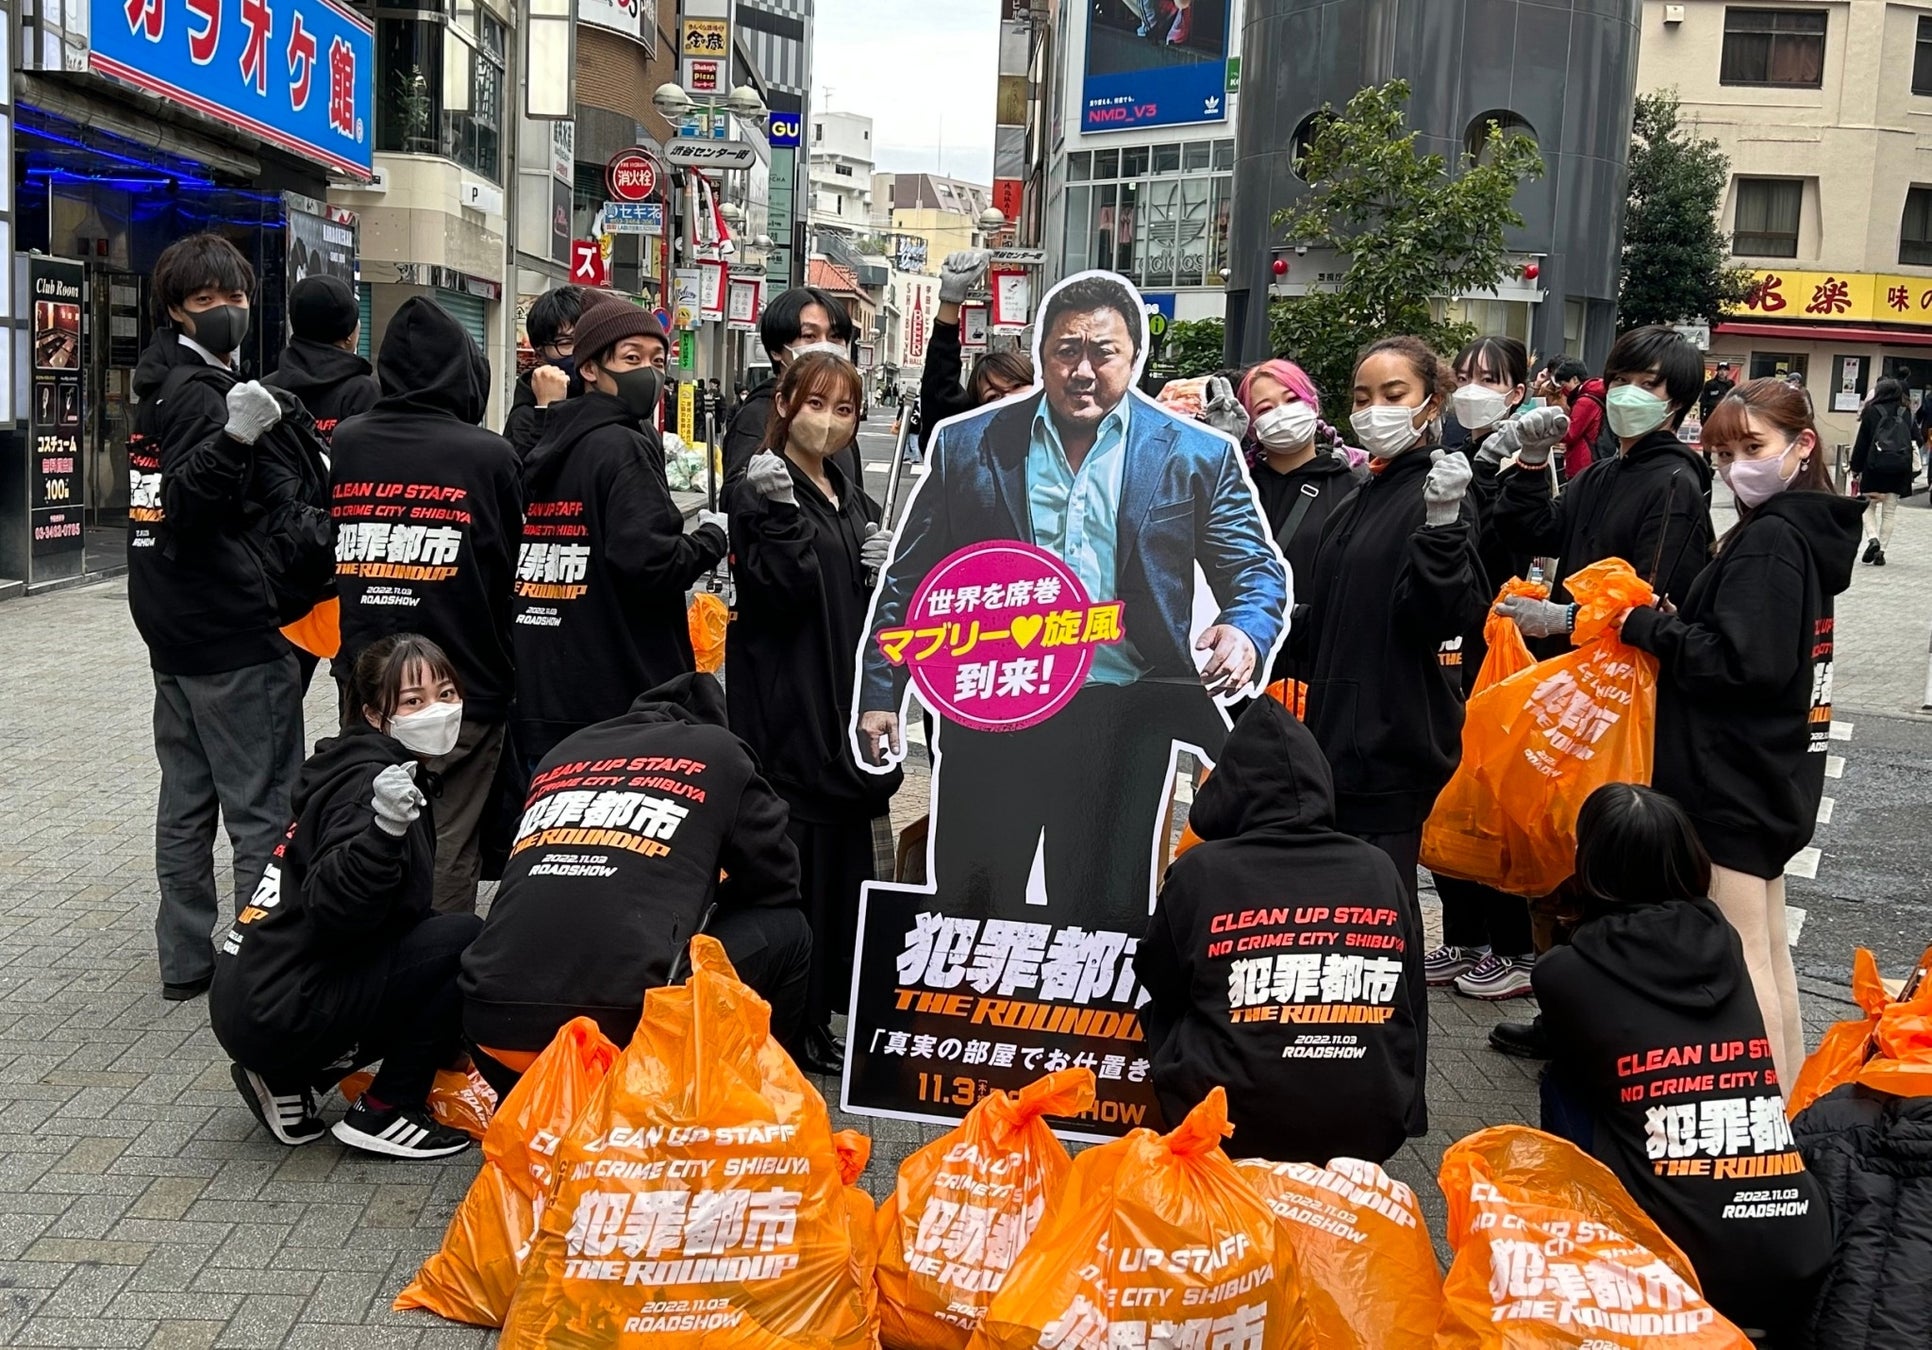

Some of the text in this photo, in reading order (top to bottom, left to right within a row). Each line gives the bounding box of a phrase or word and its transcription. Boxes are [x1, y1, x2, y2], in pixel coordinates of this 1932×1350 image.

[1089, 104, 1157, 122] NMD_V3
[772, 121, 798, 137] GU
[670, 145, 750, 160] 渋谷センター街
[618, 169, 652, 187] 消火栓
[576, 247, 597, 278] ズ
[36, 278, 79, 298] Club Room
[37, 436, 77, 453] コスチューム
[376, 484, 403, 498] UP
[405, 485, 468, 502] STAFF
[342, 505, 373, 517] CRIME
[375, 506, 407, 518] CITY
[410, 507, 473, 524] SHIBUYA
[335, 523, 463, 565] 犯罪都市
[335, 563, 459, 581] THE ROUNDUP
[360, 595, 421, 607] ROADSHOW
[366, 586, 413, 595] 2022.11.03
[927, 577, 1062, 617] 世界を席巻
[1438, 652, 1463, 666] THE
[953, 655, 1055, 702] 到来!
[530, 757, 707, 791] CLEAN UP STAFF
[537, 777, 584, 799] CRIME
[581, 776, 626, 787] CITY
[627, 776, 707, 803] SHIBUYA
[513, 790, 690, 848] 犯罪都市
[536, 828, 672, 858] ROUNDUP
[541, 854, 609, 864] 2022.11.03
[528, 864, 619, 878] ROADSHOW
[1210, 907, 1398, 934] CLEAN UP STAFF
[1208, 939, 1233, 958] NO
[1236, 932, 1296, 952] CRIME
[1298, 932, 1340, 946] CITY
[1227, 953, 1403, 1008] 犯罪都市
[894, 988, 975, 1017] THE
[1229, 1005, 1395, 1025] THE ROUNDUP
[1294, 1035, 1358, 1045] 2022.11.03
[1282, 1046, 1367, 1059] ROADSHOW
[1617, 1045, 1703, 1078] CLEAN
[1709, 1041, 1745, 1063] UP
[918, 1072, 975, 1106] 11.3
[1620, 1084, 1645, 1103] NO
[1650, 1075, 1715, 1097] CRIME
[1719, 1071, 1759, 1090] CITY
[715, 1124, 797, 1146] STAFF
[594, 1159, 667, 1181] CRIME
[666, 1158, 717, 1179] CITY
[723, 1157, 811, 1177] SHIBUYA
[1651, 1159, 1711, 1177] THE
[1733, 1188, 1799, 1203] 2022.11.03
[1280, 1191, 1359, 1225] 2022.11.03
[1722, 1200, 1809, 1219] ROADSHOW
[564, 1186, 803, 1259] 犯罪都市
[1118, 1247, 1164, 1273] UP
[1166, 1231, 1253, 1276] STAFF
[563, 1254, 799, 1287] THE ROUNDUP
[1121, 1262, 1276, 1308] CITY SHIBUYA
[640, 1298, 731, 1314] 2022.11.03
[1491, 1300, 1556, 1323] THE
[623, 1311, 743, 1333] ROADSHOW
